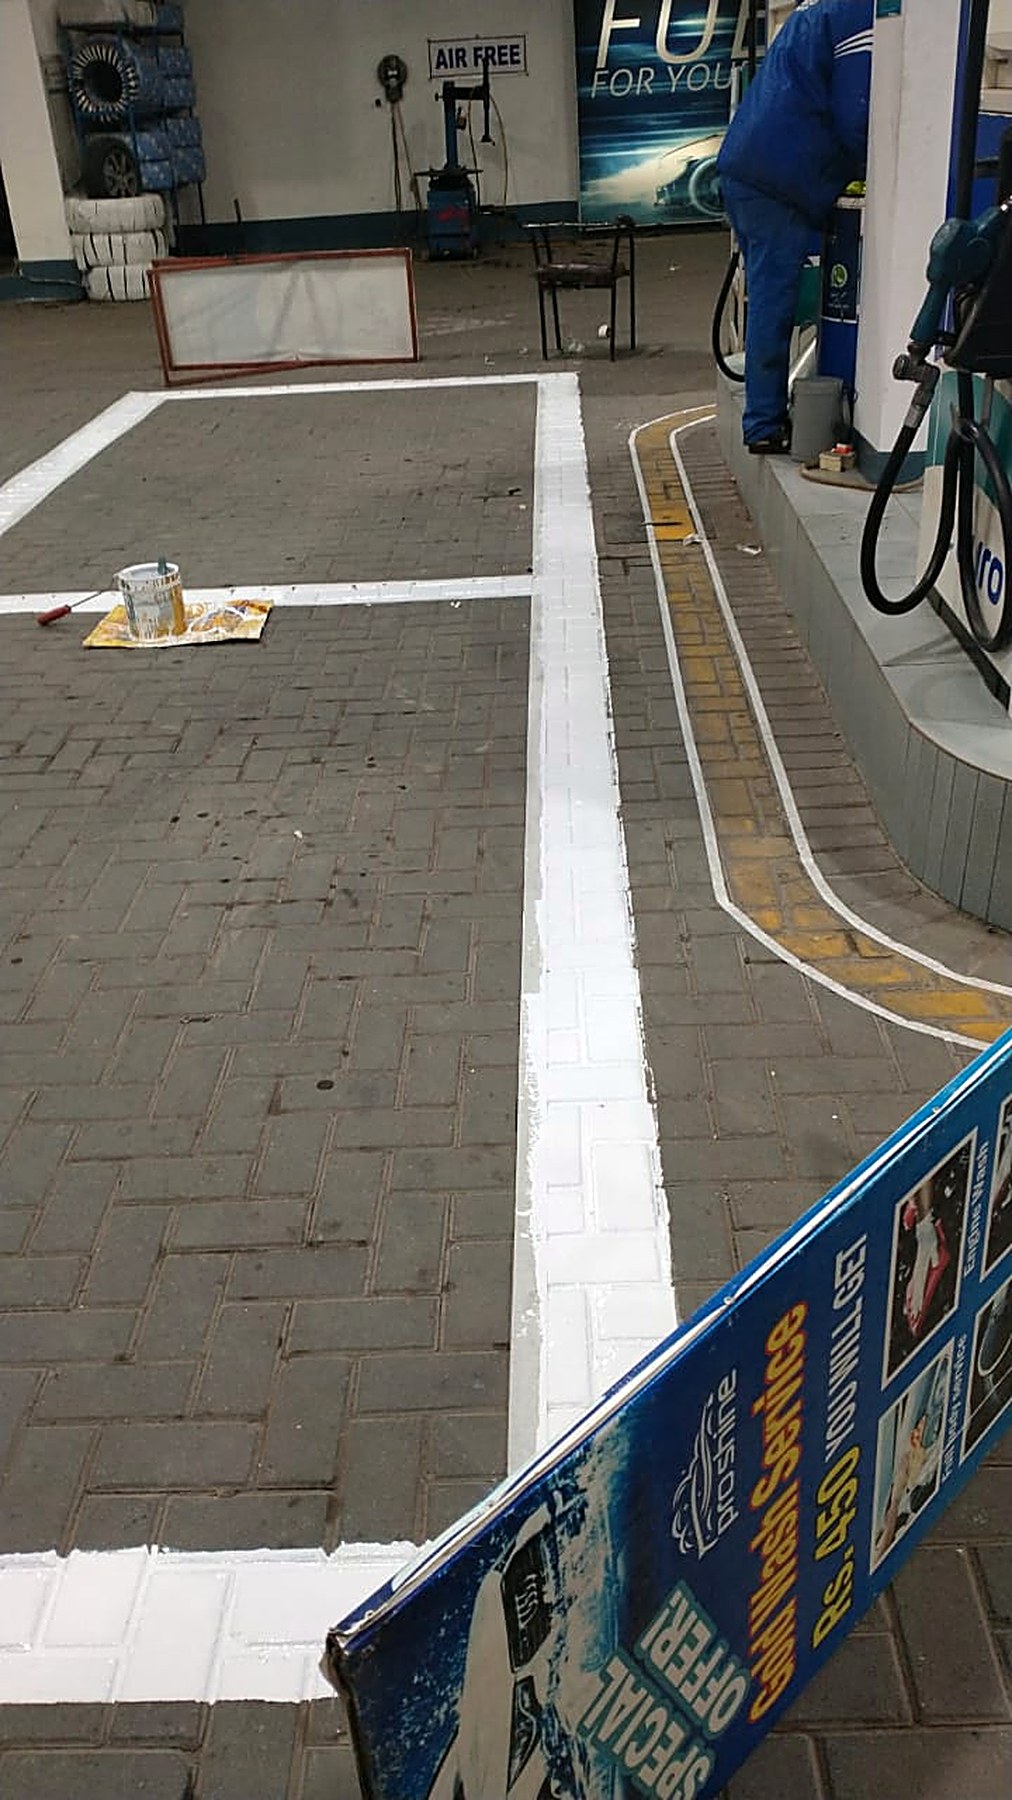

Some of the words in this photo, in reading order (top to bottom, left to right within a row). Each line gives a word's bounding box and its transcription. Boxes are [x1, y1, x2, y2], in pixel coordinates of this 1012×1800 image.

[436, 47, 467, 69] AIR
[473, 44, 521, 67] FREE
[591, 67, 655, 99] FOR
[667, 61, 749, 93] YOU
[972, 1141, 989, 1206] Wash
[833, 1233, 867, 1310] GET
[964, 1203, 981, 1277] Engine
[829, 1296, 863, 1396] WILL
[713, 1368, 739, 1535] proshine
[750, 1302, 807, 1509] Service
[825, 1381, 857, 1463] YOU
[815, 1446, 860, 1560] 450
[750, 1479, 799, 1634] Wash
[812, 1545, 855, 1649] Rs.
[640, 1590, 747, 1733] OFFER!
[749, 1597, 797, 1723] Gold
[584, 1656, 711, 1800] SPECIAL
